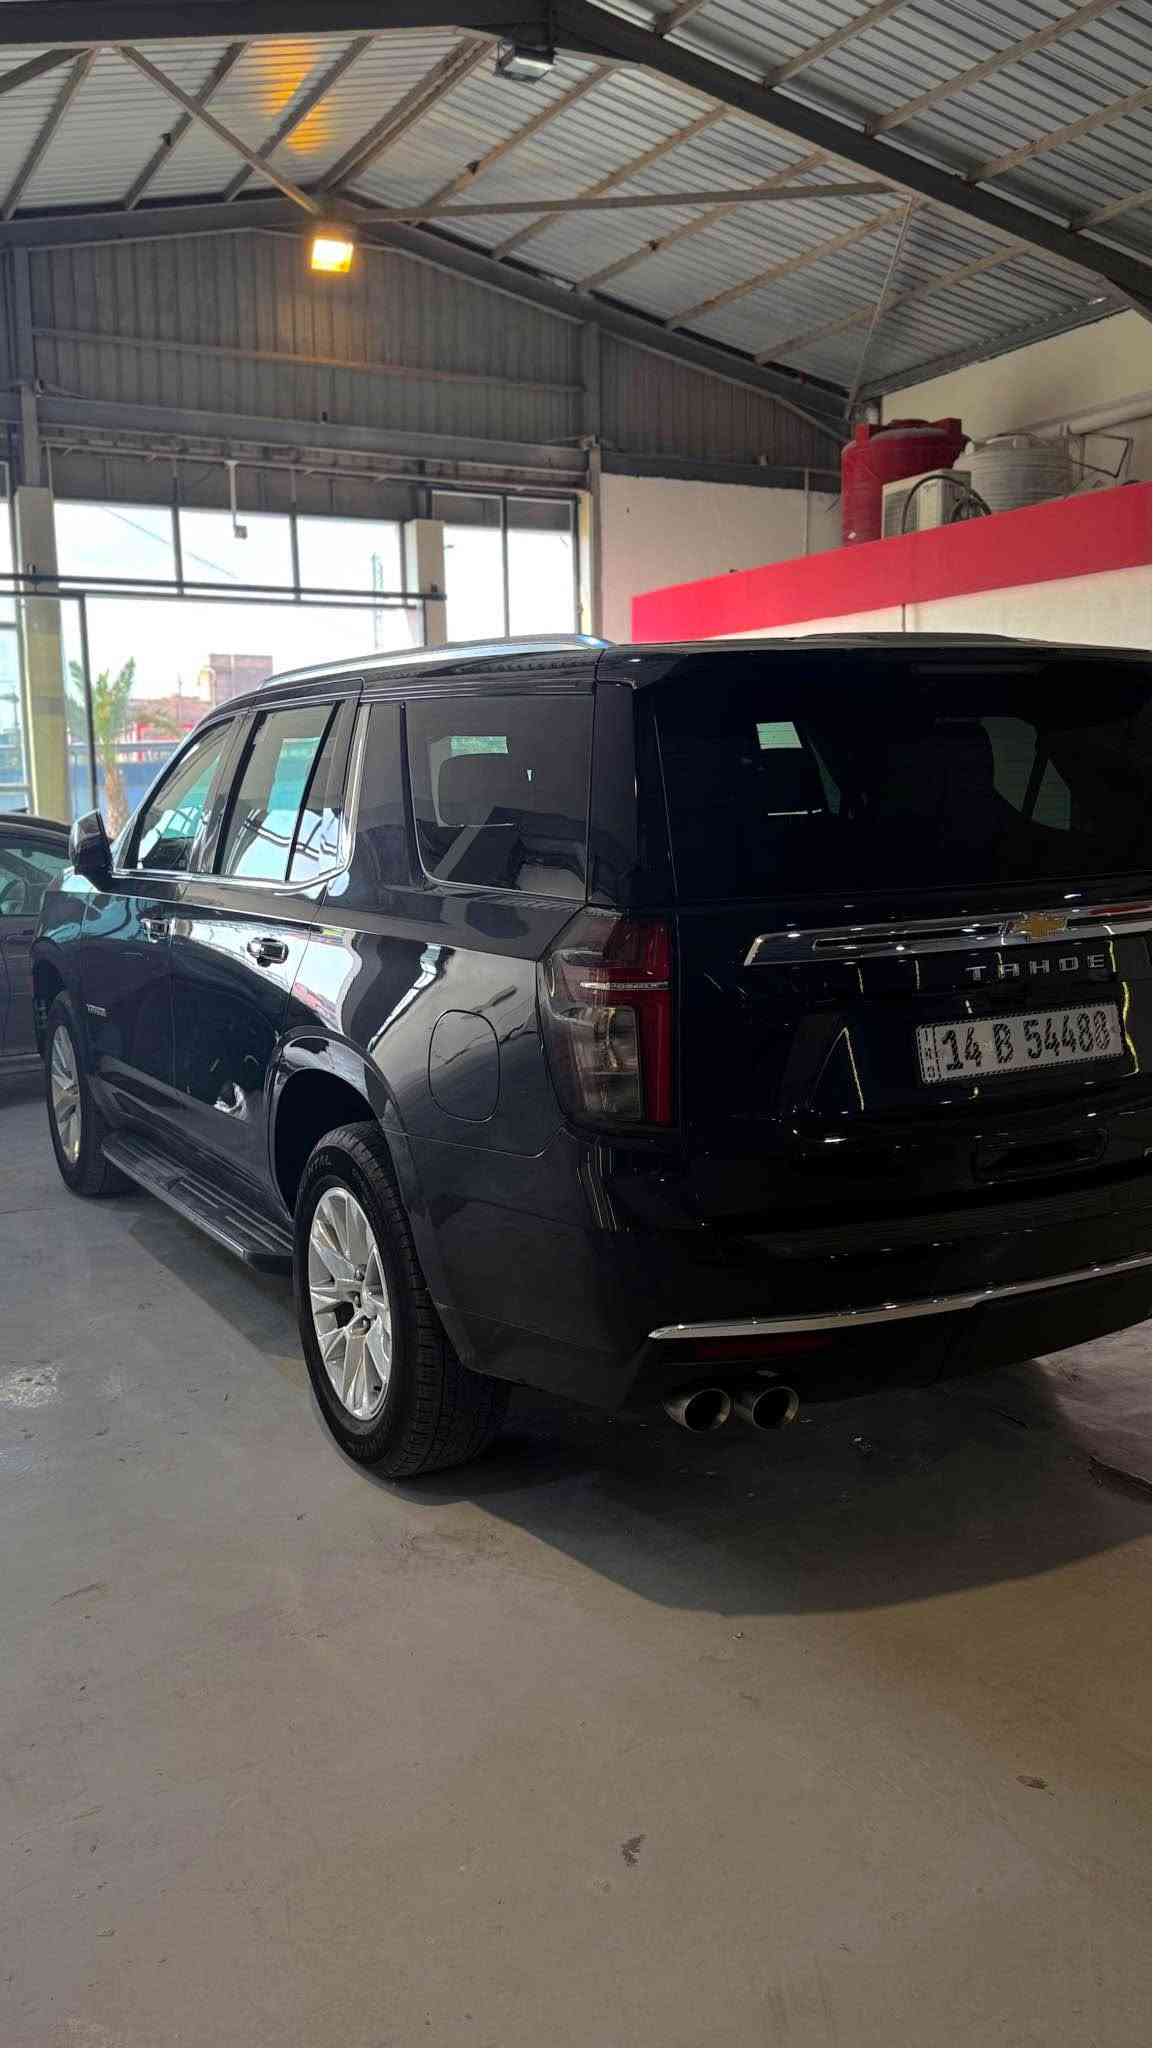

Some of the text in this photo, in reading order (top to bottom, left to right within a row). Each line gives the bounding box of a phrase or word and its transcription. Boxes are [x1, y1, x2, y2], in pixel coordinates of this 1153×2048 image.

[965, 953, 1105, 981] TAHOE
[941, 1026, 983, 1070] 14
[992, 1022, 1014, 1064] B
